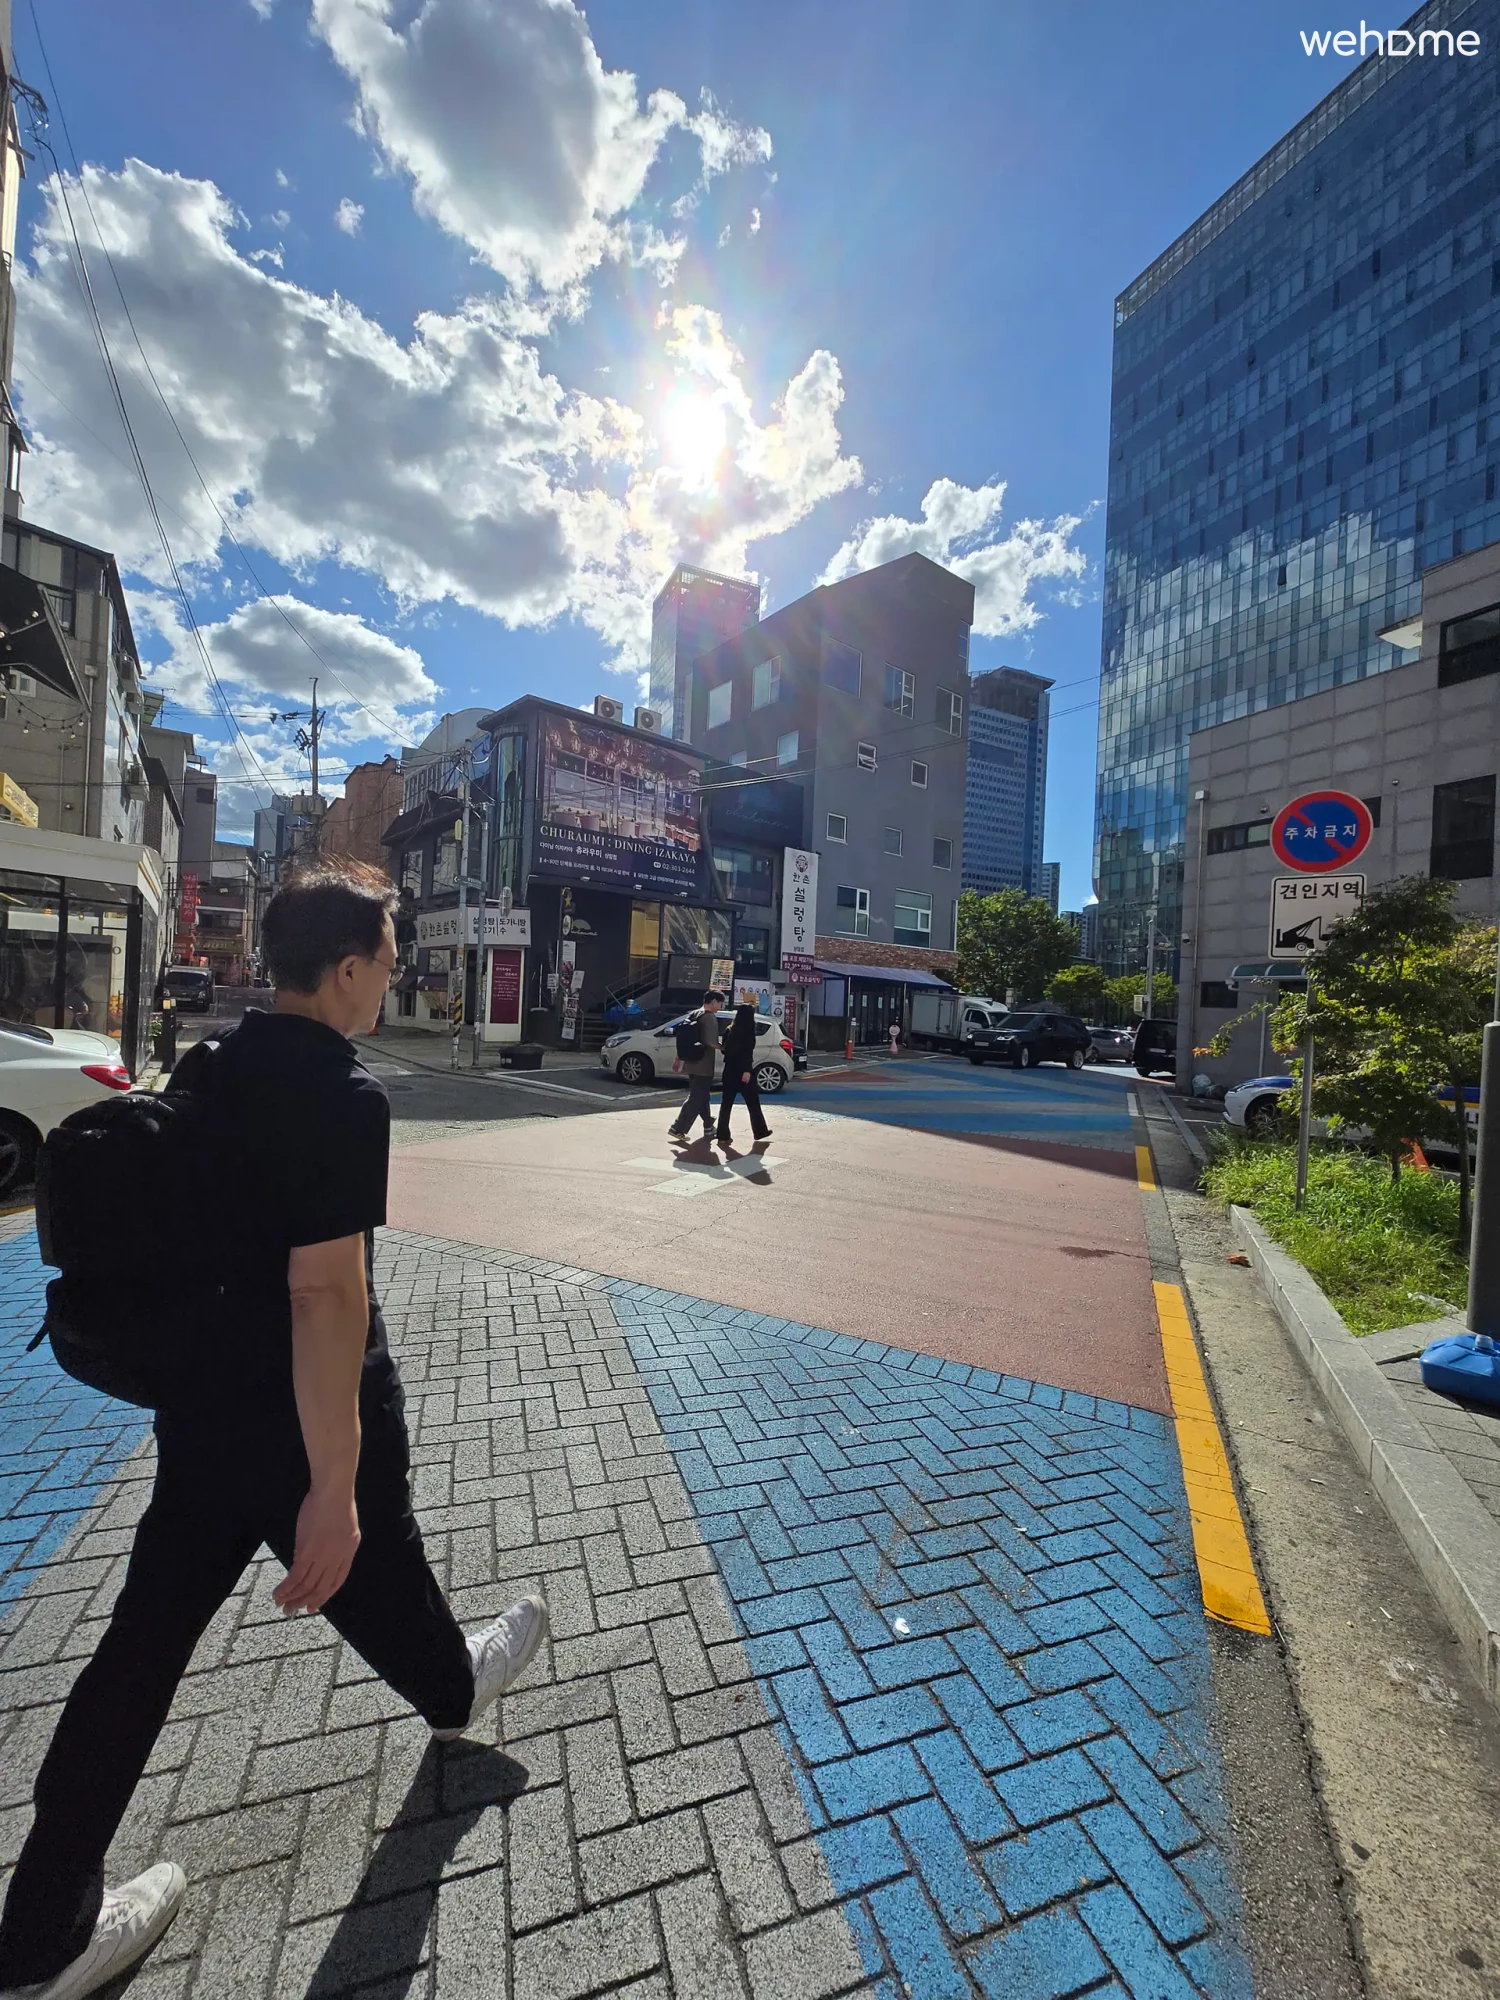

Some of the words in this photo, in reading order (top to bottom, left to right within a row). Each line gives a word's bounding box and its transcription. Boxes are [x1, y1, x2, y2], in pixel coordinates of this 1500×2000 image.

[1284, 823, 1356, 840] 주차금지
[540, 825, 605, 846] CHURAUMI
[614, 838, 652, 855] DINING
[654, 848, 697, 864] IZAKAYA
[576, 845, 602, 858] 츄라우미
[1280, 881, 1360, 900] 견인지역
[499, 917, 527, 927] 도가니탕
[793, 887, 806, 942] 설렁탕
[429, 919, 457, 937] 한촌설렁
